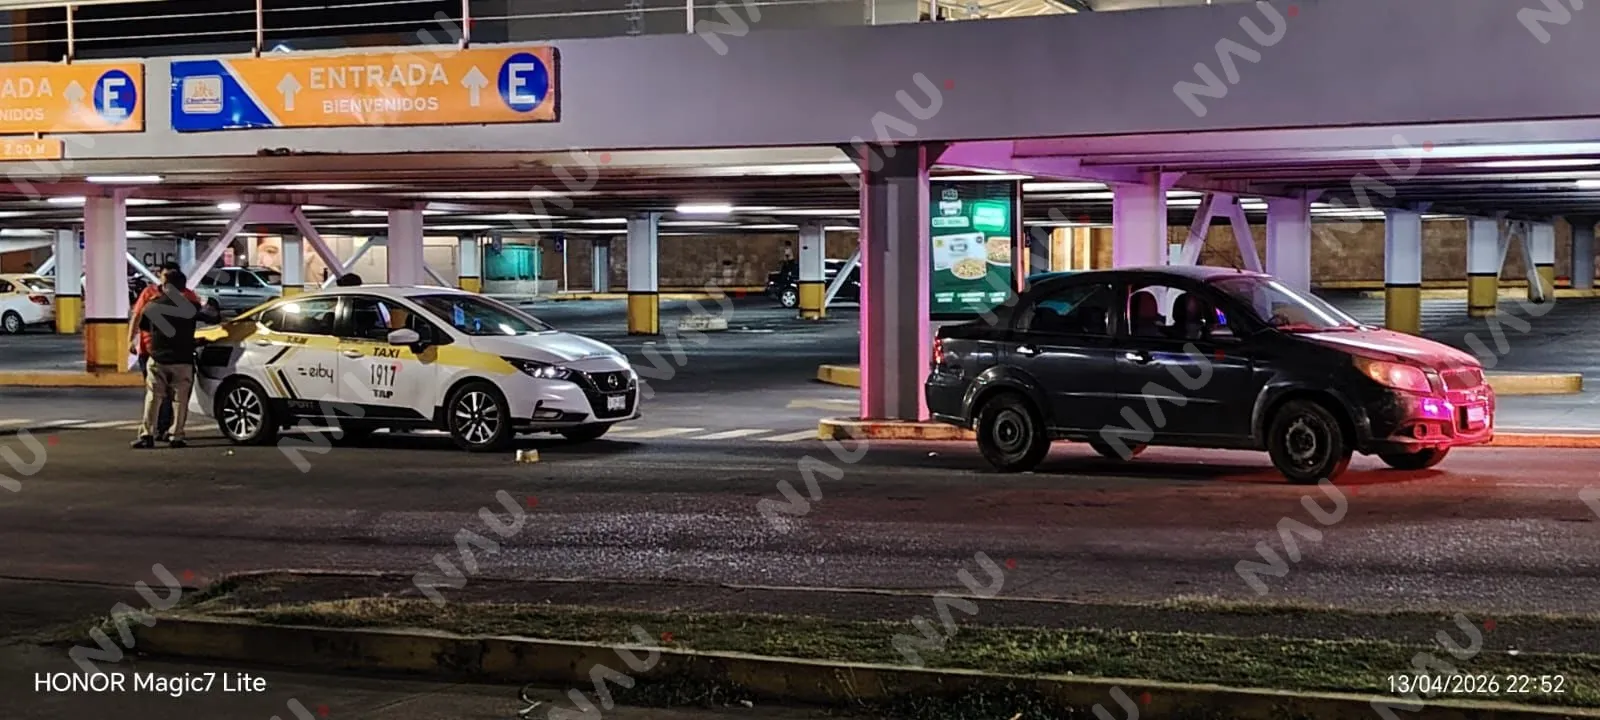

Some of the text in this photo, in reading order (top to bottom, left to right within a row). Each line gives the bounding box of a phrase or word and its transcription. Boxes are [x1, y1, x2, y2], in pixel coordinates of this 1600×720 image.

[310, 63, 449, 89] ENTRADA
[509, 63, 536, 105] E
[103, 78, 126, 116] E
[323, 97, 439, 114] BIENVENIDOS
[373, 347, 400, 358] TAXI
[370, 364, 397, 387] 1917
